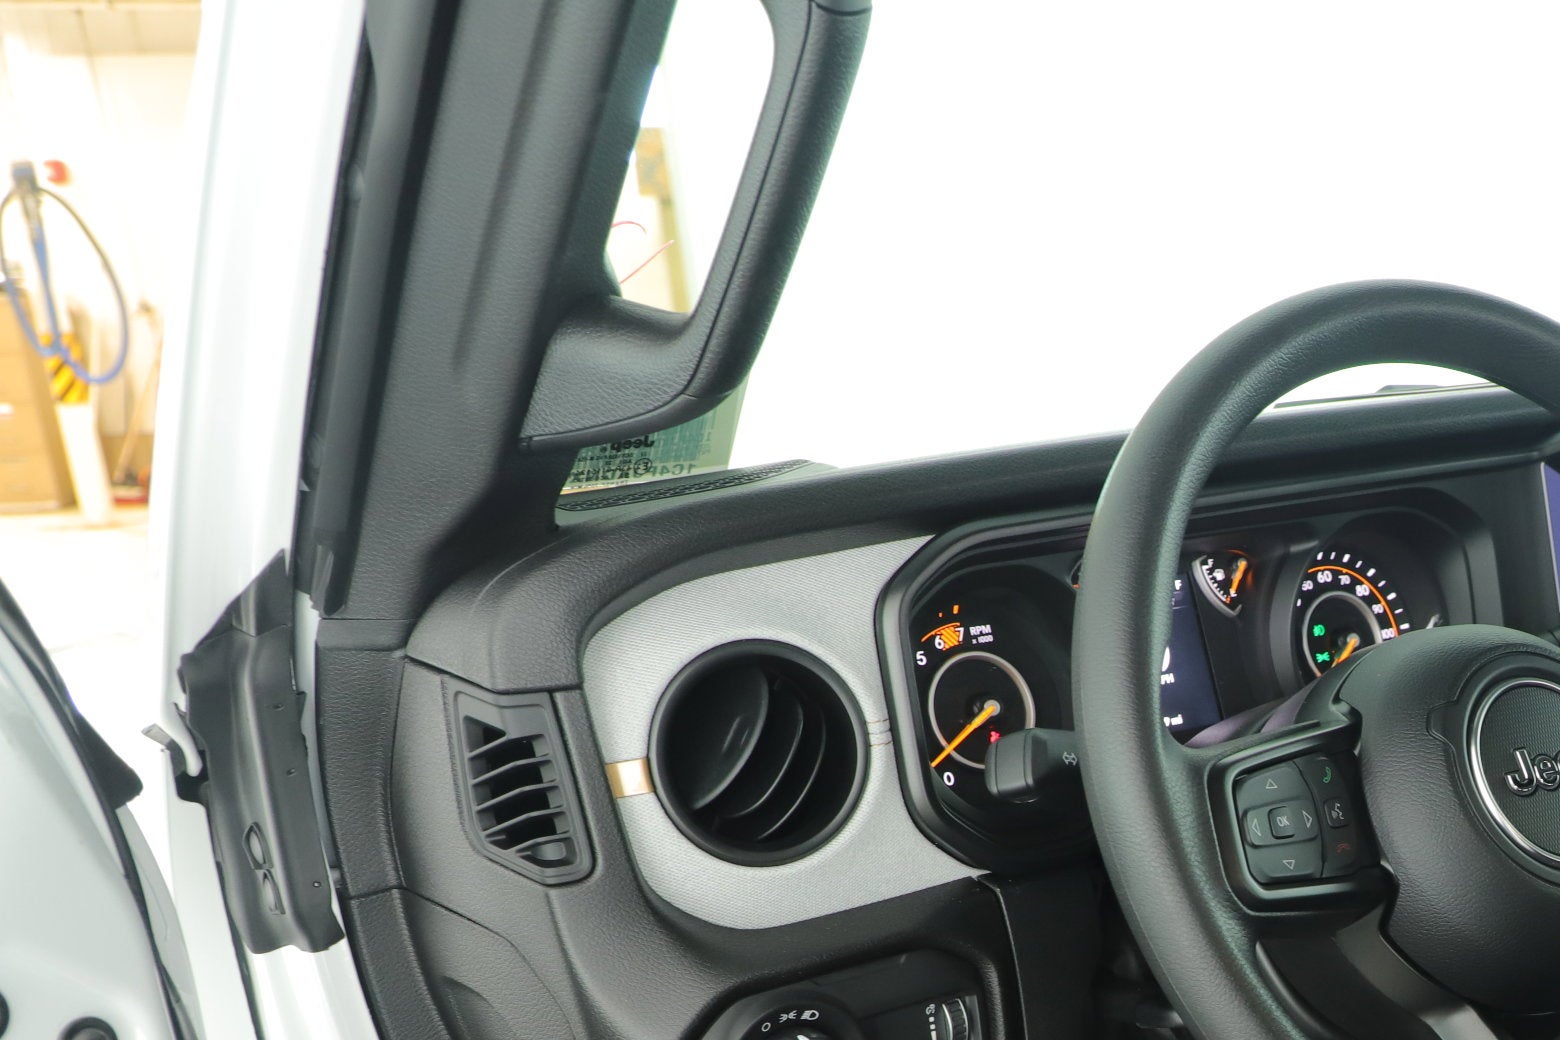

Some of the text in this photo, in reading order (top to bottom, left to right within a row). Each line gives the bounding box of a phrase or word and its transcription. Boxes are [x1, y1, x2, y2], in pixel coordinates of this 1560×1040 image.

[1317, 570, 1332, 583] 60
[1338, 575, 1351, 585] 70
[1355, 584, 1370, 597] 80
[1372, 603, 1384, 614] 90
[955, 627, 965, 641] 7
[969, 624, 992, 636] RPM
[1381, 628, 1395, 639] 100
[934, 635, 945, 649] 6
[916, 651, 927, 666] 5
[943, 771, 955, 786] 0
[1276, 815, 1290, 827] OK
